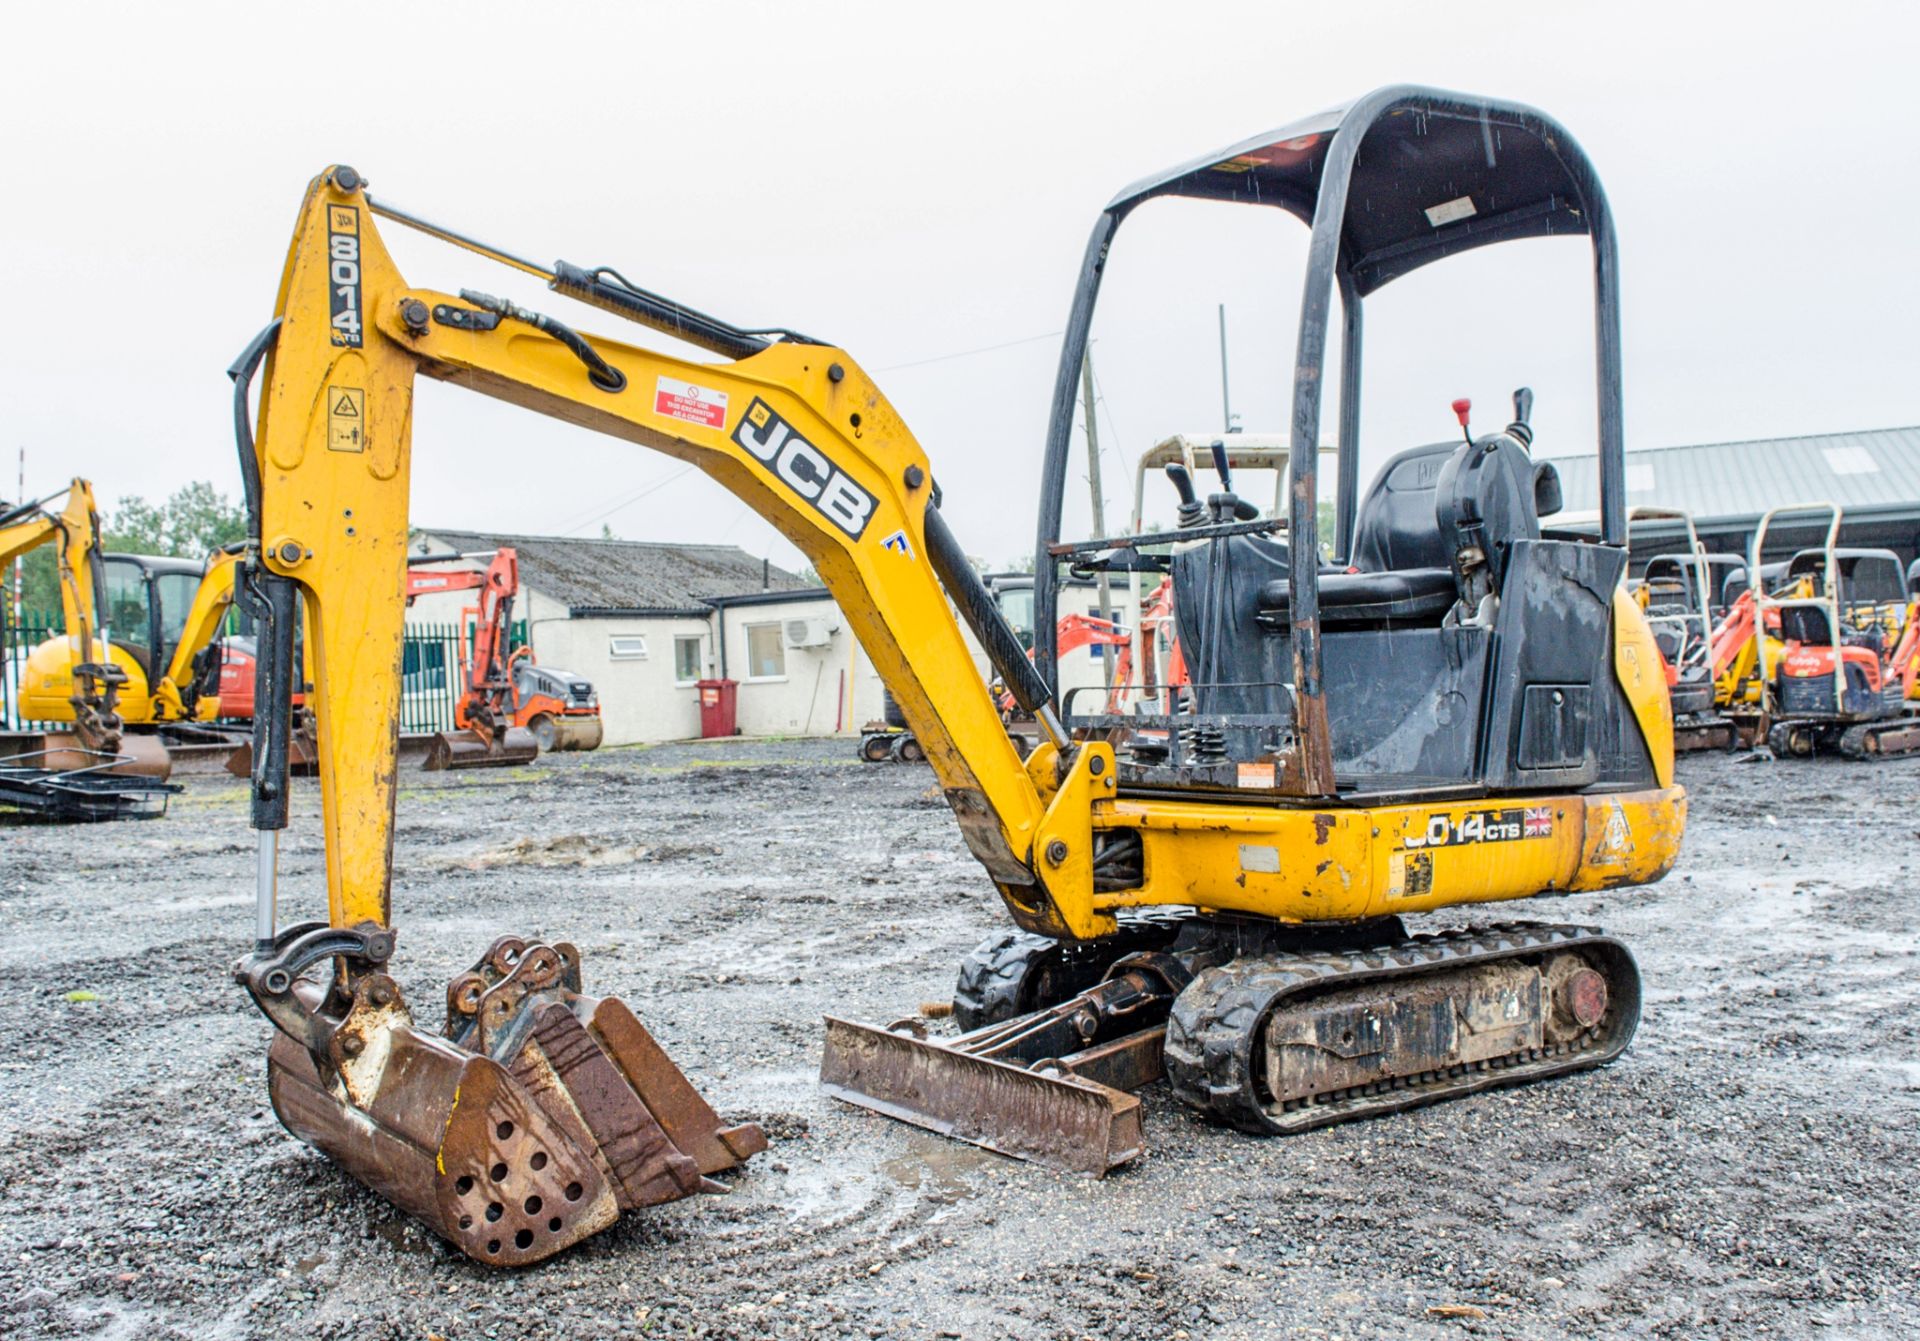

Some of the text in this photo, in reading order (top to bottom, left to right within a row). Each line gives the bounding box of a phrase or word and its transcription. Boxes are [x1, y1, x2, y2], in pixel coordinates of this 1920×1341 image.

[331, 234, 361, 334] 8014
[739, 420, 872, 535] JCB
[1486, 823, 1521, 840] CTS
